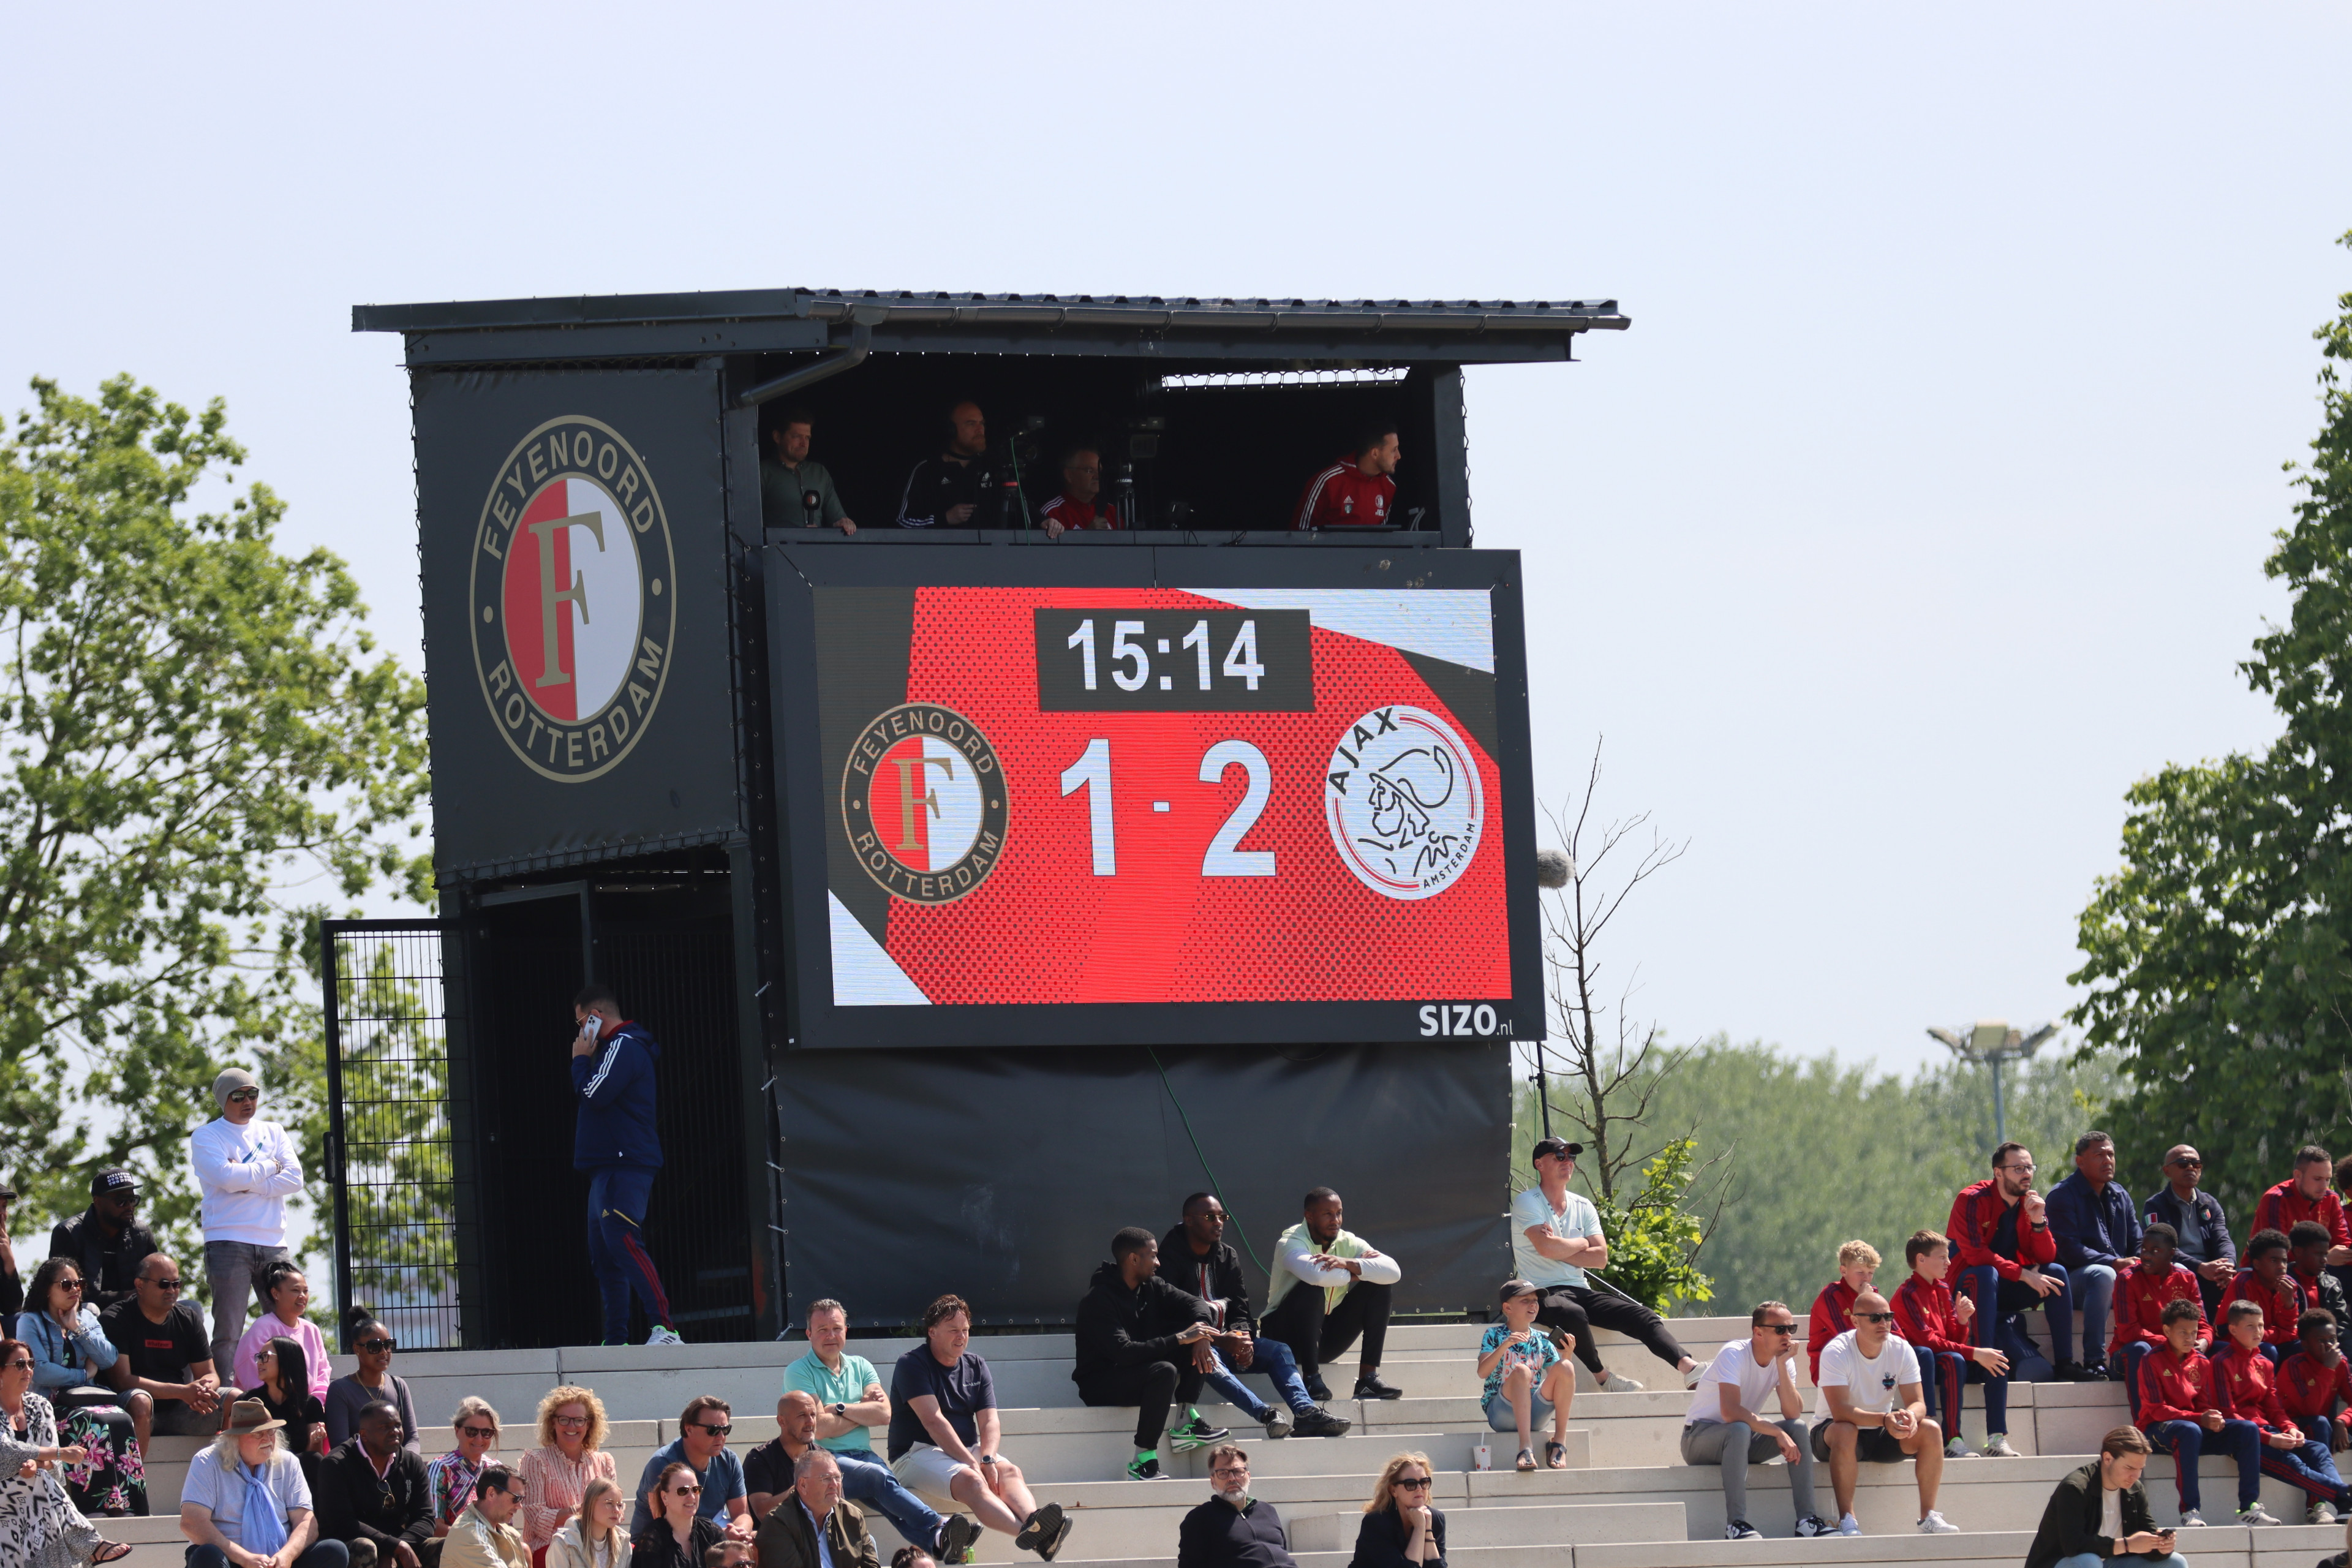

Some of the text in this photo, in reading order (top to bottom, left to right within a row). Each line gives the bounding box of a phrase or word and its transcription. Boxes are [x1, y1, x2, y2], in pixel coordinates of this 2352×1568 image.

[483, 430, 654, 560] FEYENOORD
[528, 510, 606, 688] F
[1068, 619, 1265, 692] 15:14
[488, 635, 663, 767] ROTTERDAM
[853, 710, 993, 775] FEYENOORD
[1328, 707, 1399, 796] AJAX
[891, 757, 954, 850] F
[1060, 738, 1116, 876] 1
[1198, 739, 1276, 877] 2
[856, 830, 1000, 897] ROTTERDAM
[1423, 822, 1476, 889] AMSTERDAM
[1419, 1004, 1513, 1036] SIZO.nl
